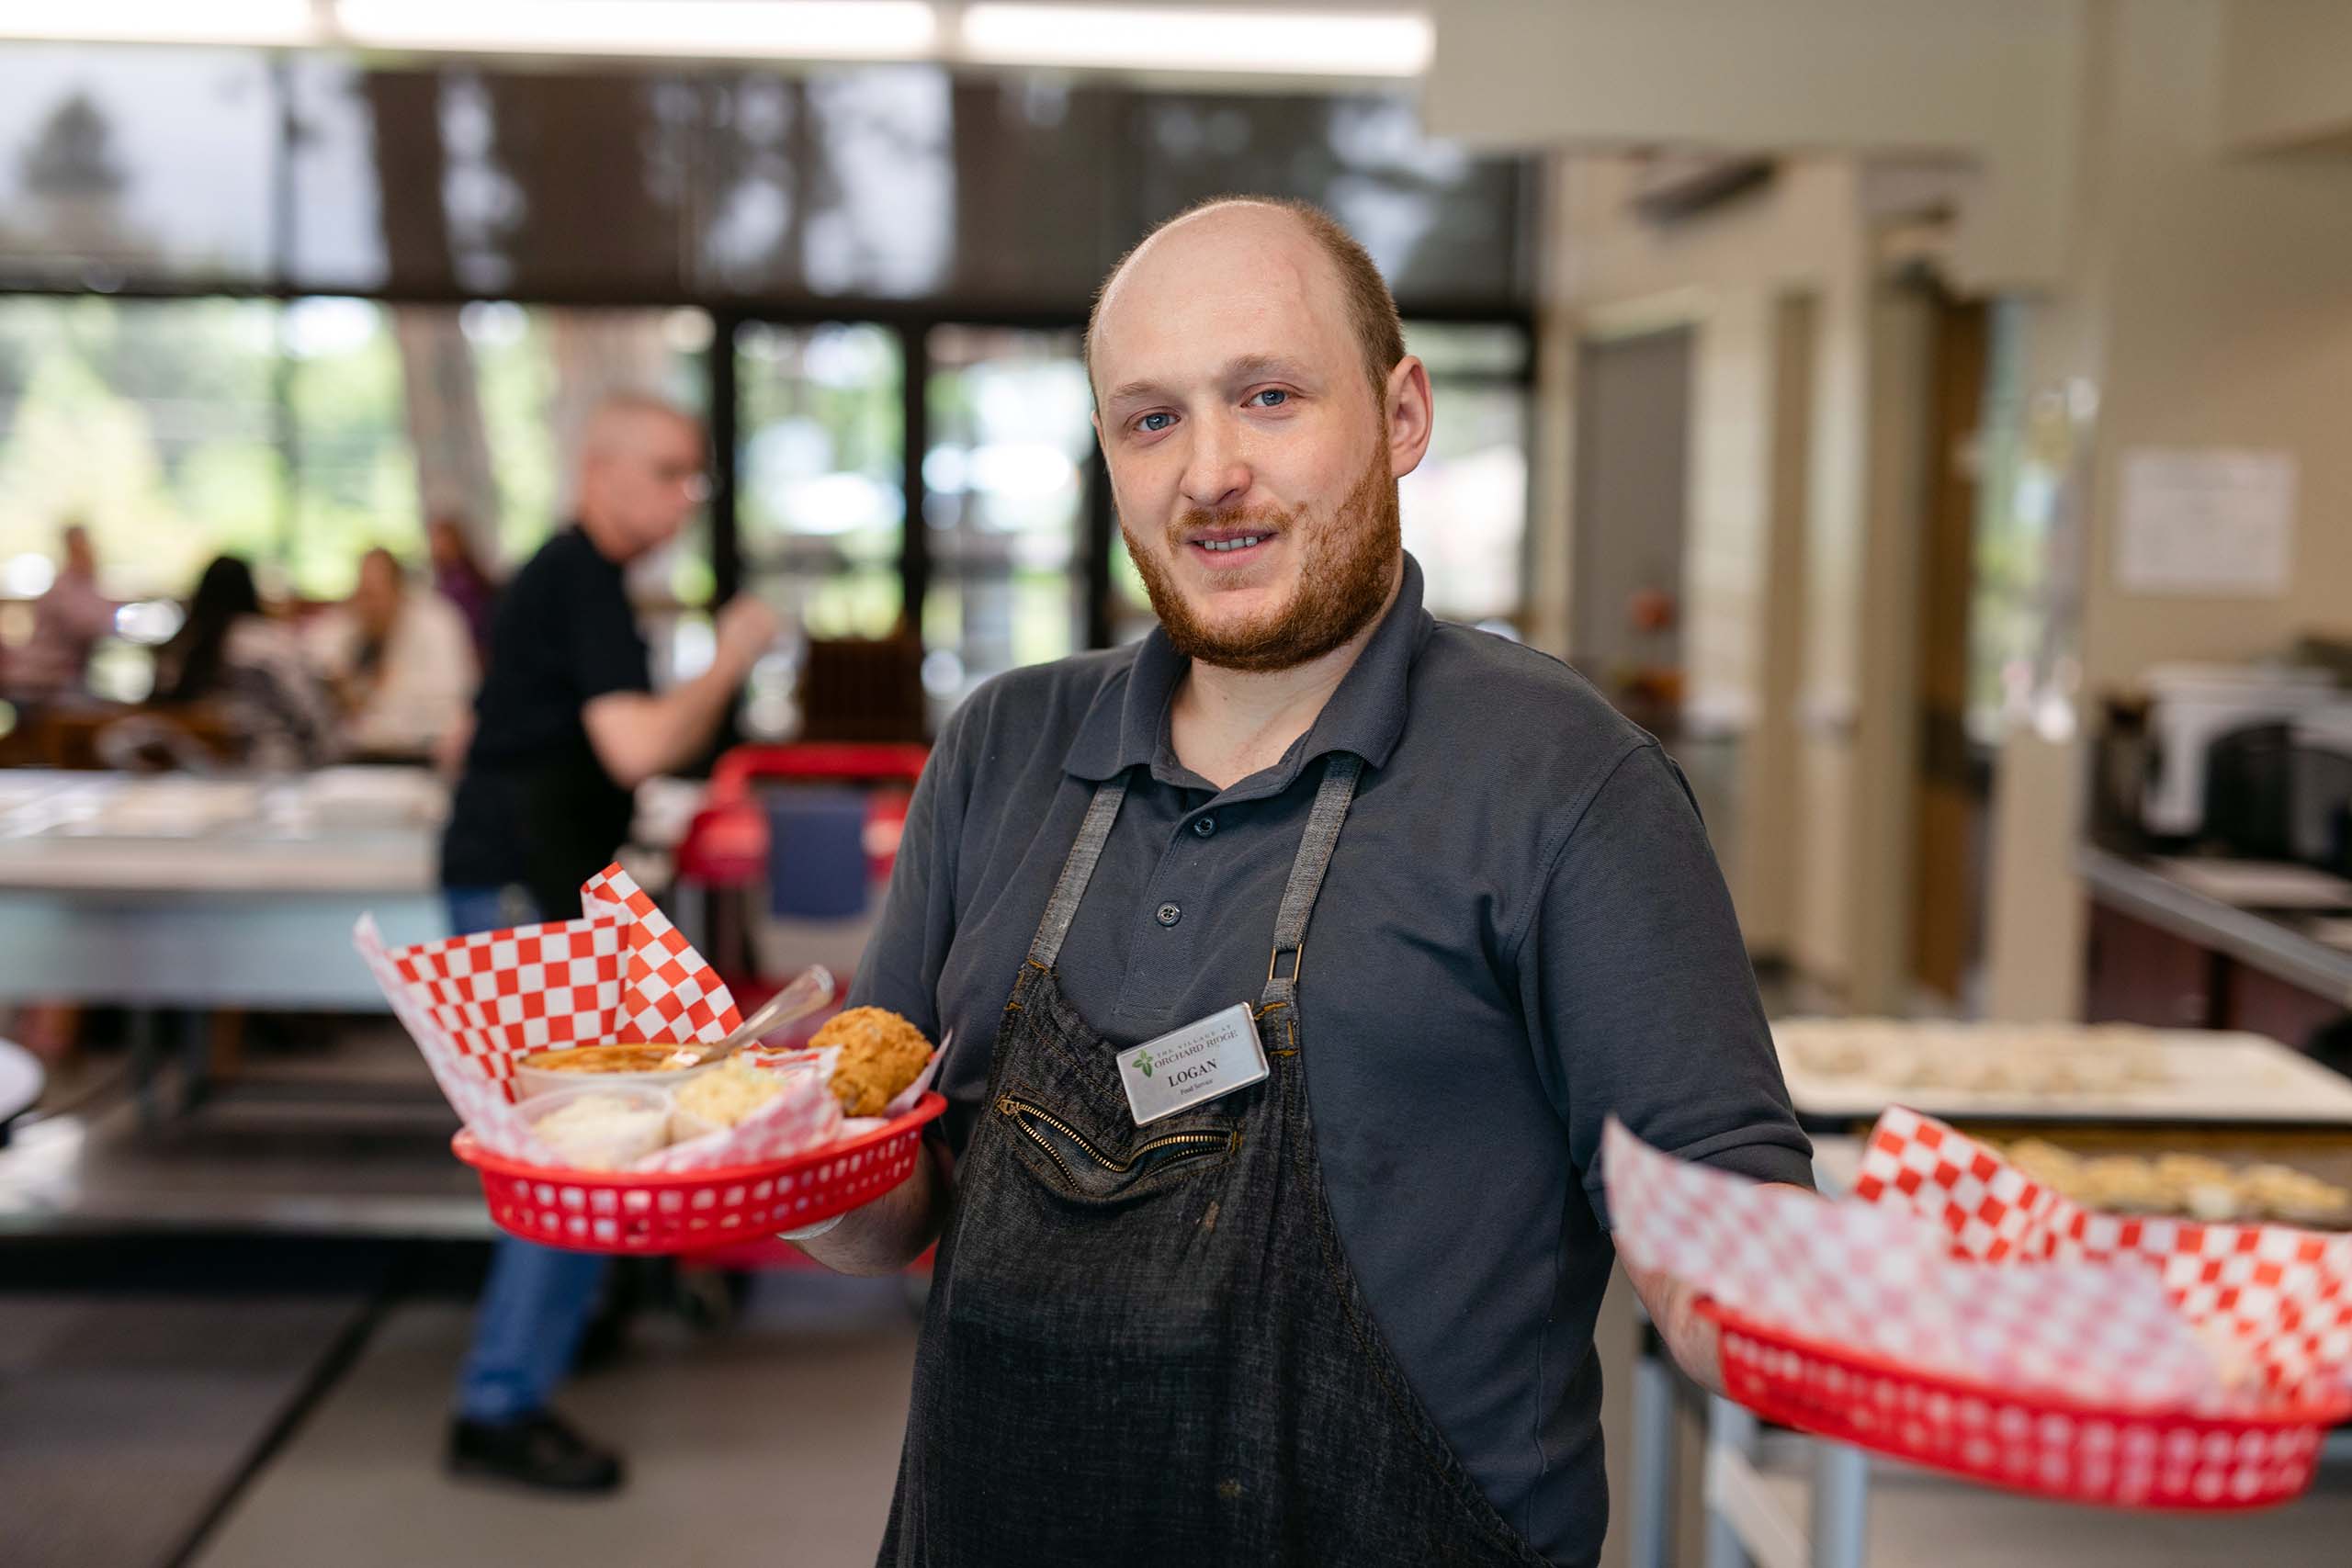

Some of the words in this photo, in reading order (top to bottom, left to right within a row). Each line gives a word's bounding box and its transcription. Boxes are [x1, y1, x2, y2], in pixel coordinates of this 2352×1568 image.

[1154, 1043, 1204, 1068] ORCHARD
[1206, 1030, 1238, 1048] RIDGE
[1168, 1058, 1218, 1087] LOGAN
[1180, 1085, 1194, 1095] Food
